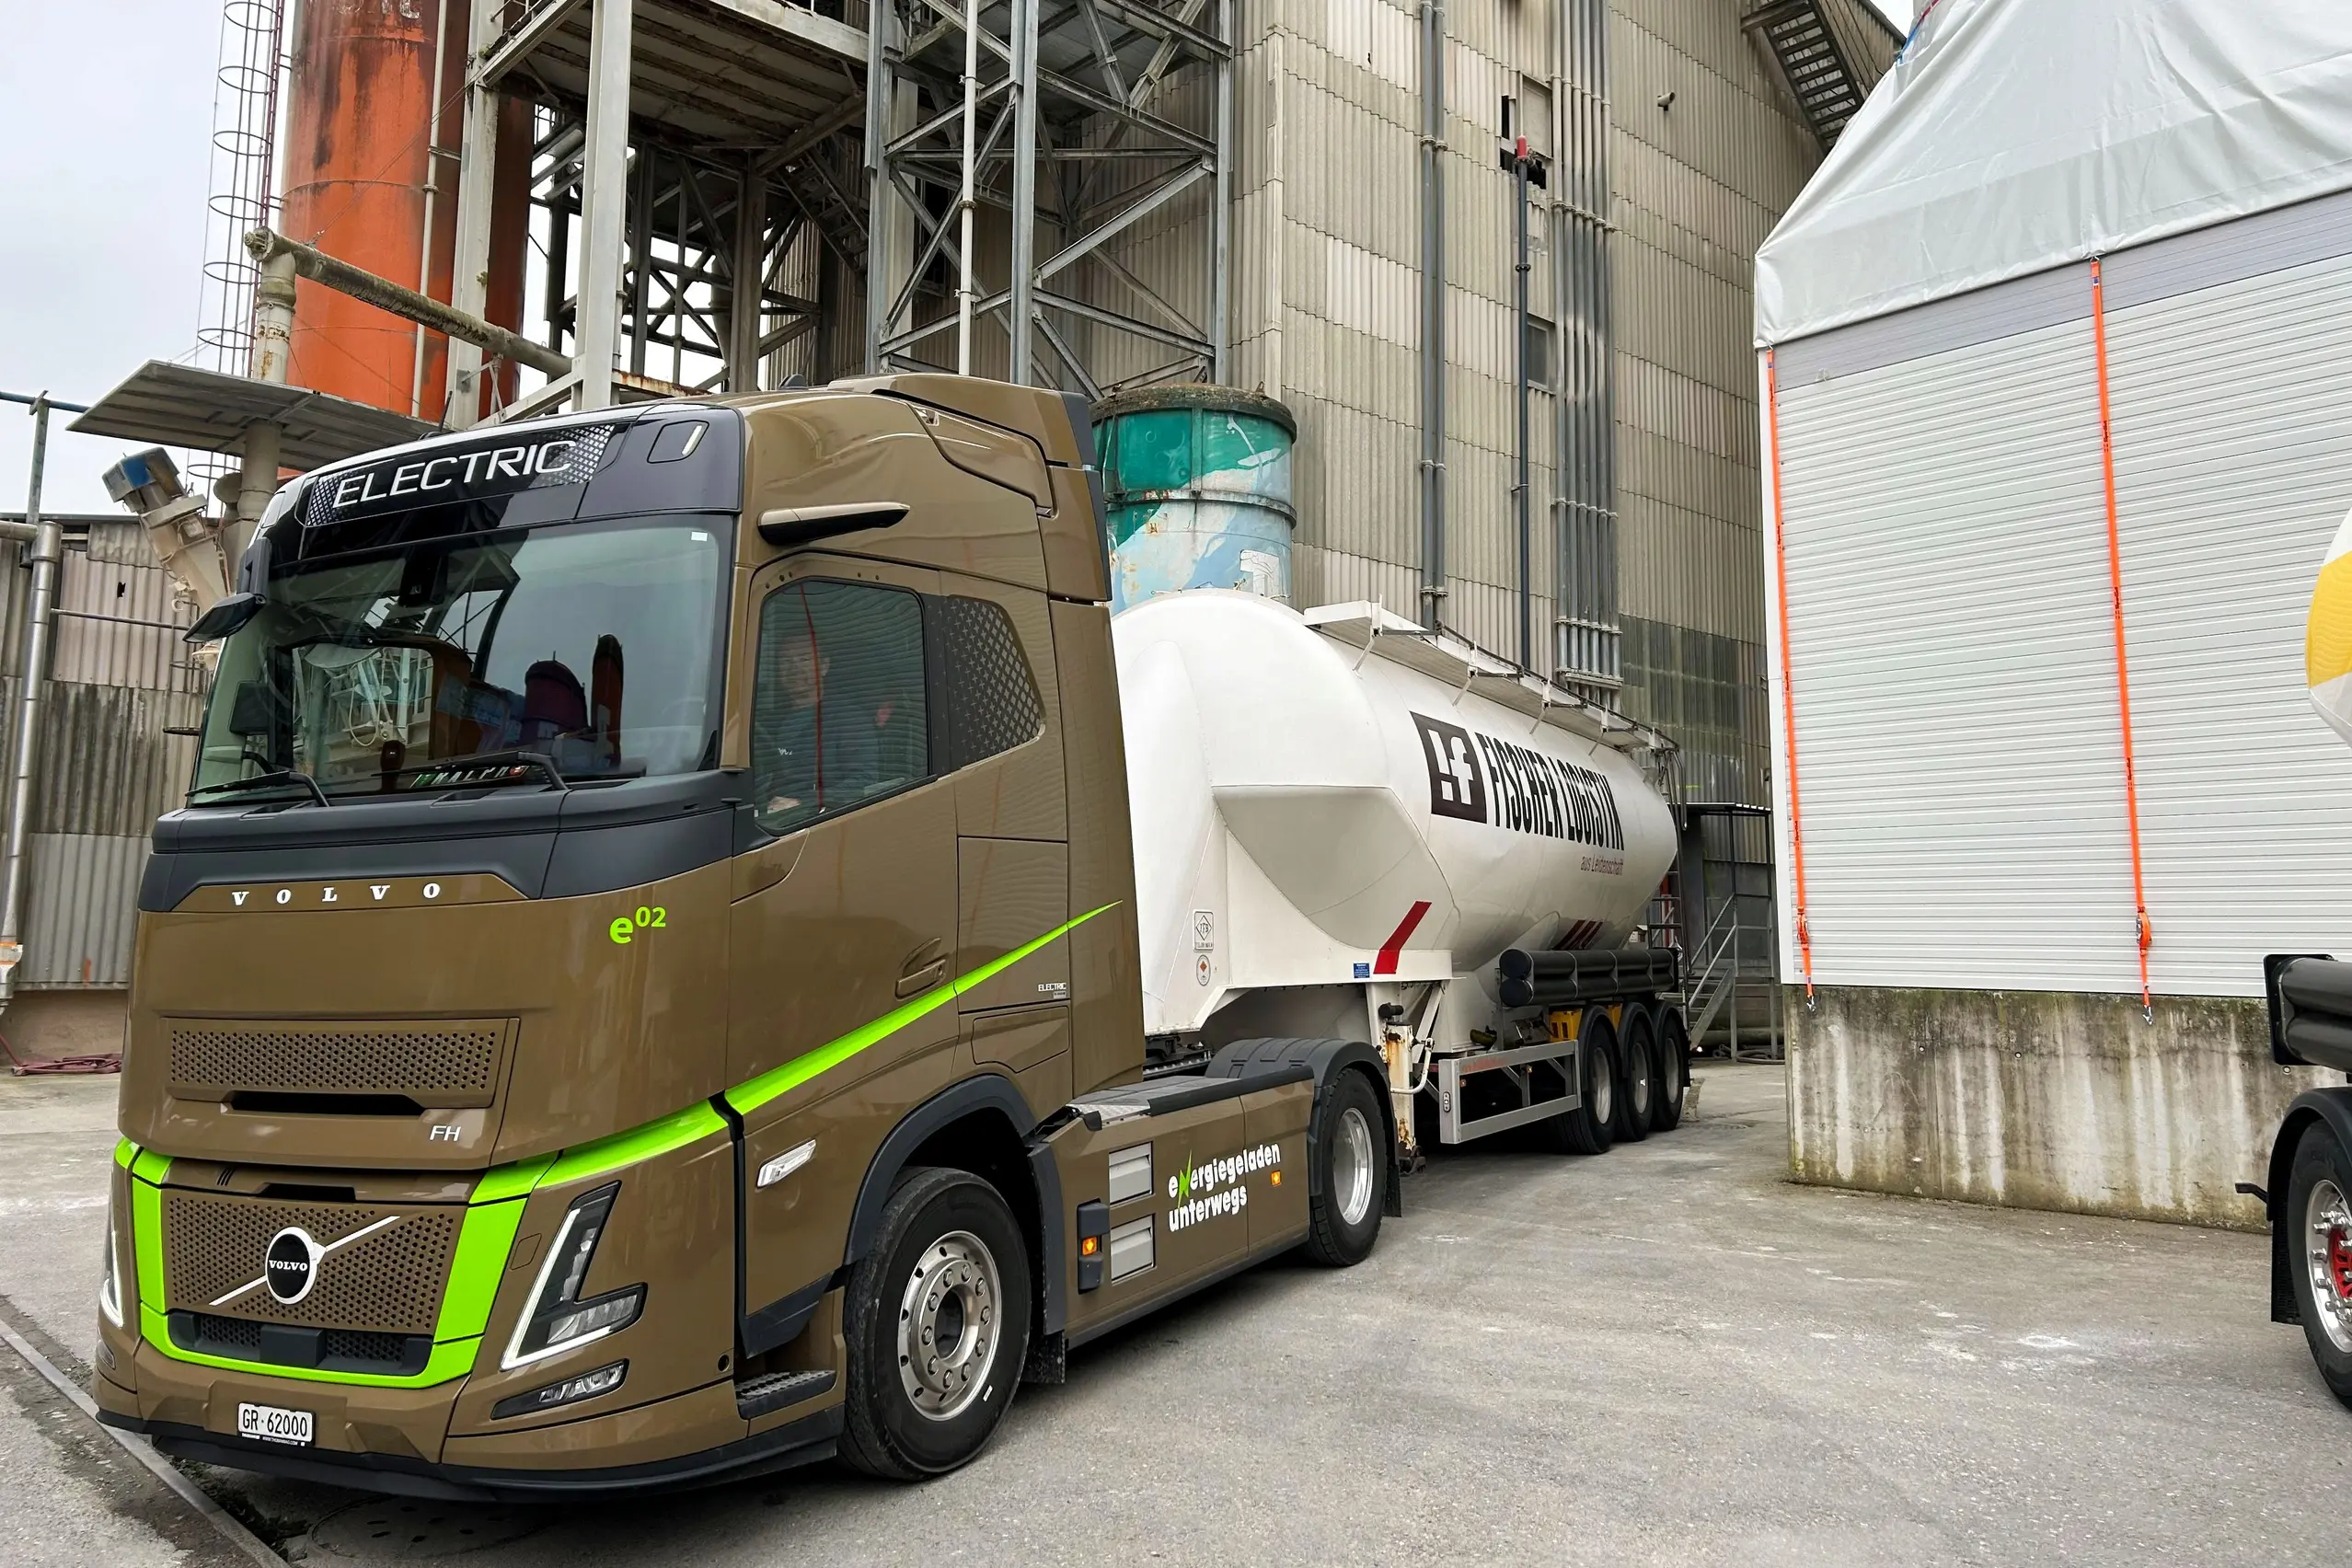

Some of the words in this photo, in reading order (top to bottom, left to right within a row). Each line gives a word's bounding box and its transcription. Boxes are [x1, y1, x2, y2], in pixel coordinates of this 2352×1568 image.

[332, 440, 577, 508] ELECTRIC
[1474, 732, 1564, 839] FISCHER
[1547, 756, 1625, 851] LOGISTIK
[232, 882, 441, 906] VOLVO
[1038, 982, 1066, 992] ELECTRIC
[429, 1124, 462, 1142] FH
[1169, 1184, 1248, 1233] unterwegs
[269, 1259, 308, 1272] VOLVO
